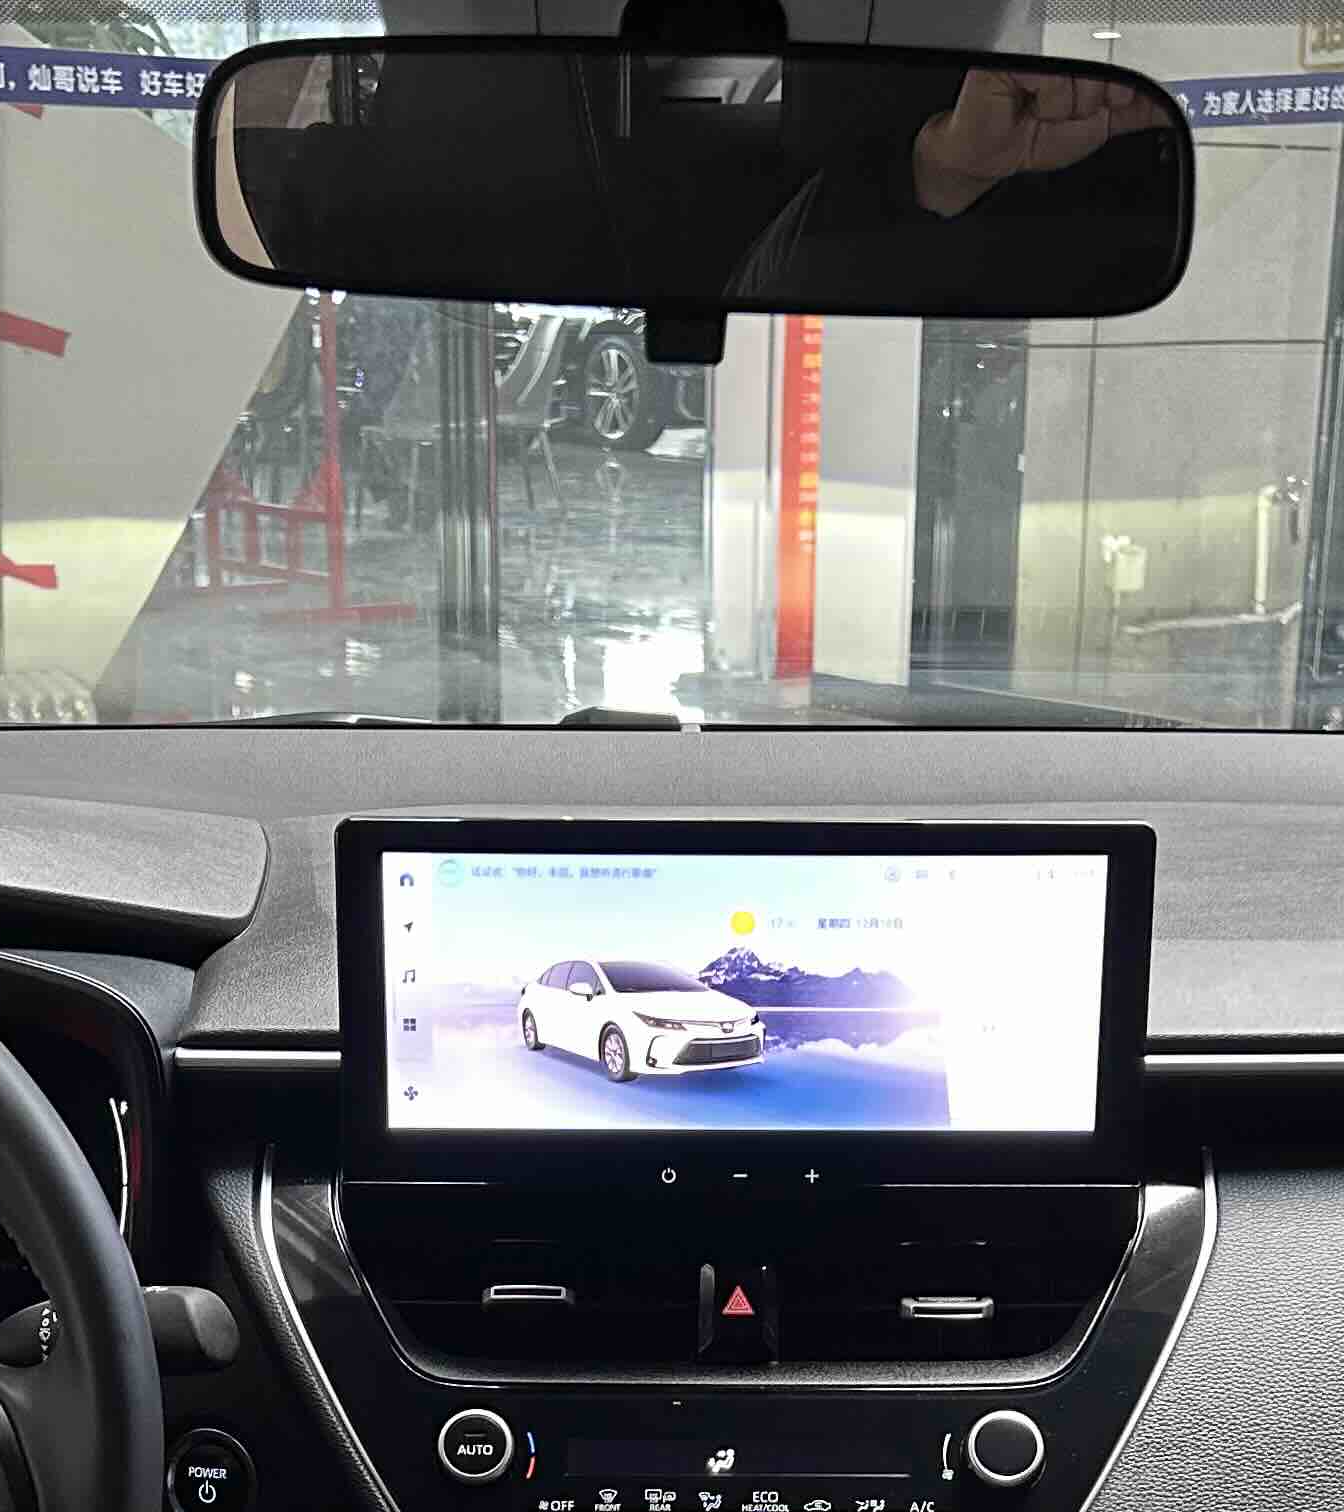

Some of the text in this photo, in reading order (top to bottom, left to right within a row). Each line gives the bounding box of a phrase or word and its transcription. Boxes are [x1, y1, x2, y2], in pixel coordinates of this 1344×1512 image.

[456, 1444, 494, 1456] AUTO
[188, 1465, 228, 1480] POWER
[752, 1491, 779, 1503] ECO
[550, 1500, 575, 1511] OFF
[594, 1503, 621, 1512] FRONT
[649, 1503, 672, 1512] REAR
[741, 1503, 790, 1512] HEAT/COOL
[909, 1501, 935, 1512] A/C
